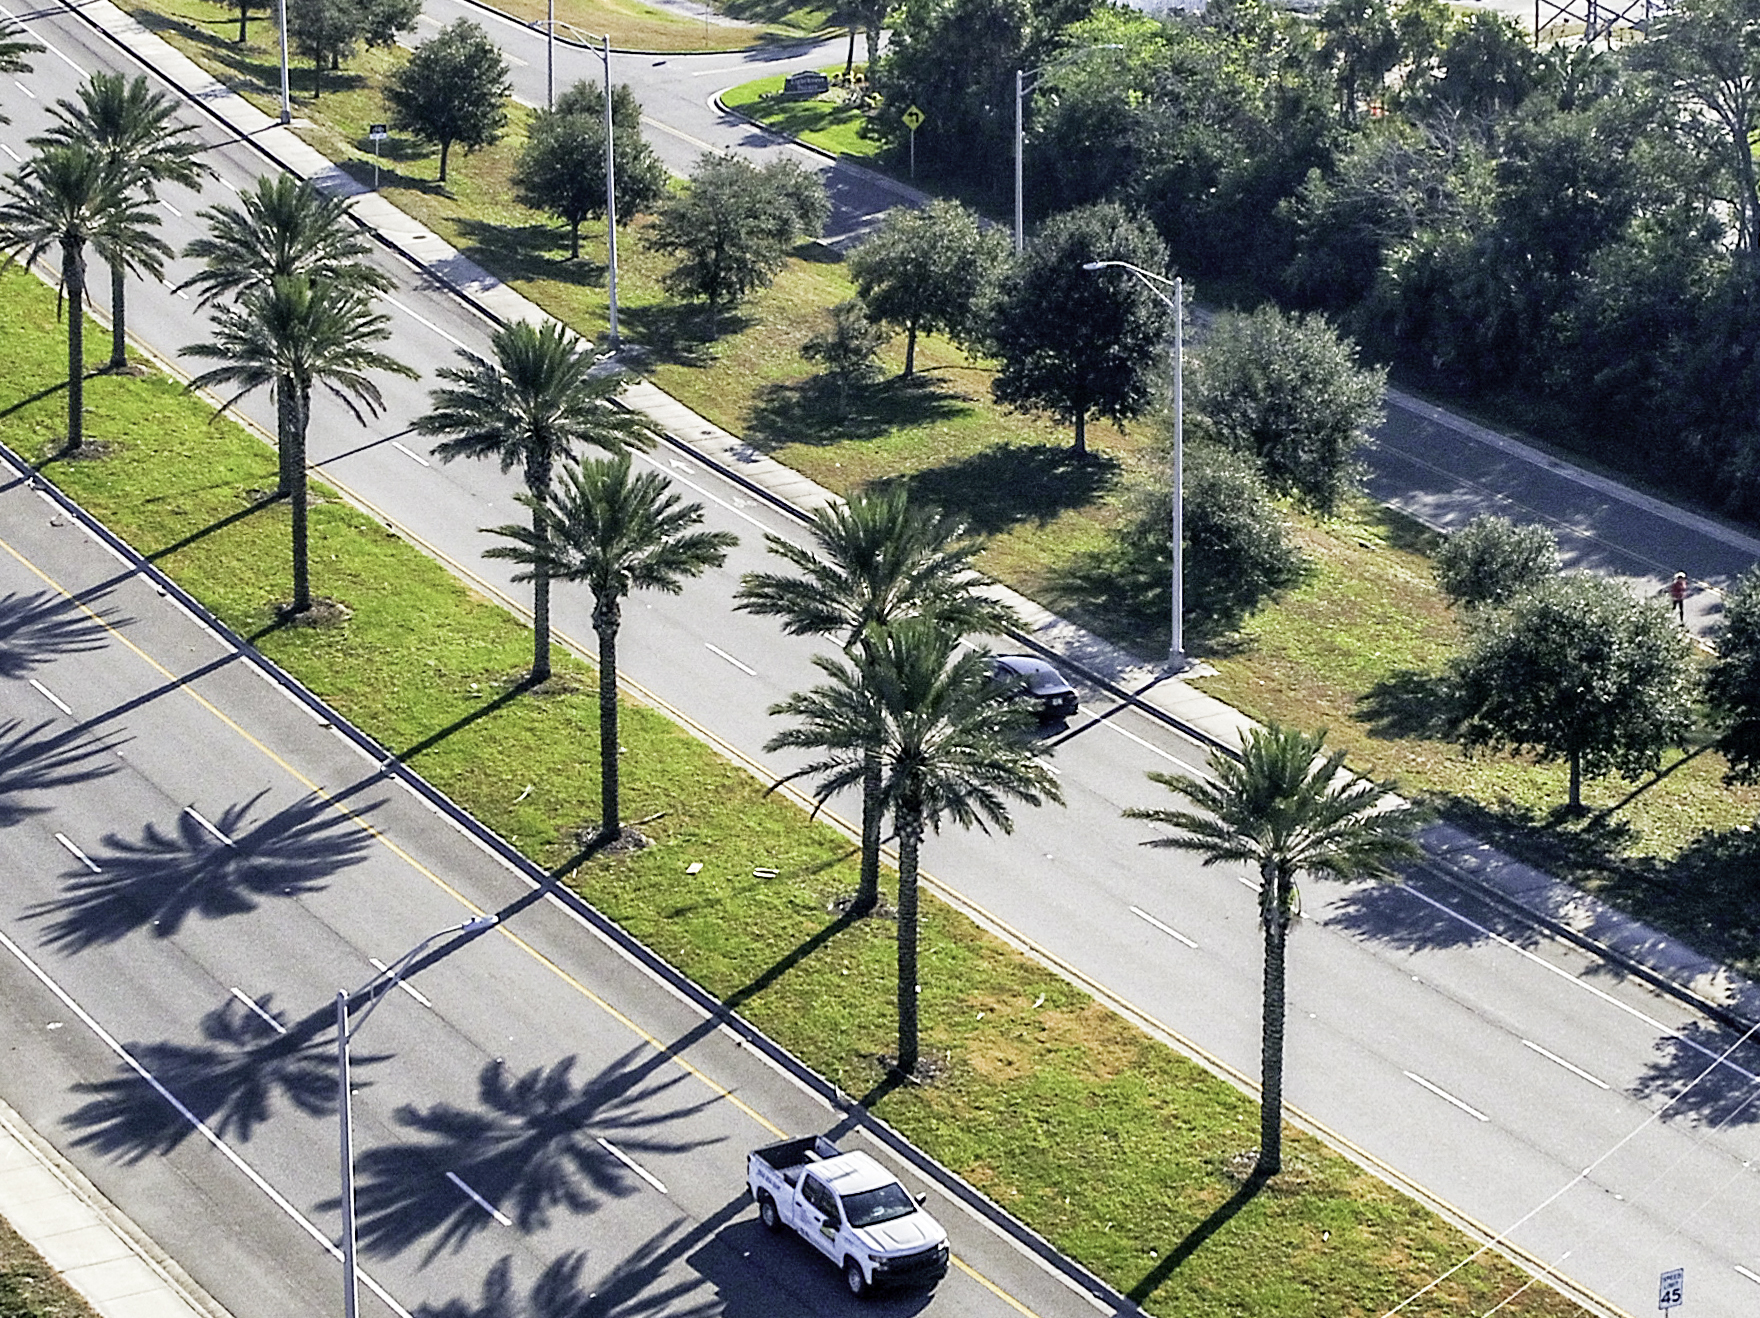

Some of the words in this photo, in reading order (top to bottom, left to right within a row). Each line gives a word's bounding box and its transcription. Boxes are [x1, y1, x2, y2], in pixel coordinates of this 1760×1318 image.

[1663, 1273, 1681, 1282] SPEED
[1663, 1280, 1679, 1290] LIMIT
[1660, 1288, 1681, 1303] 45
